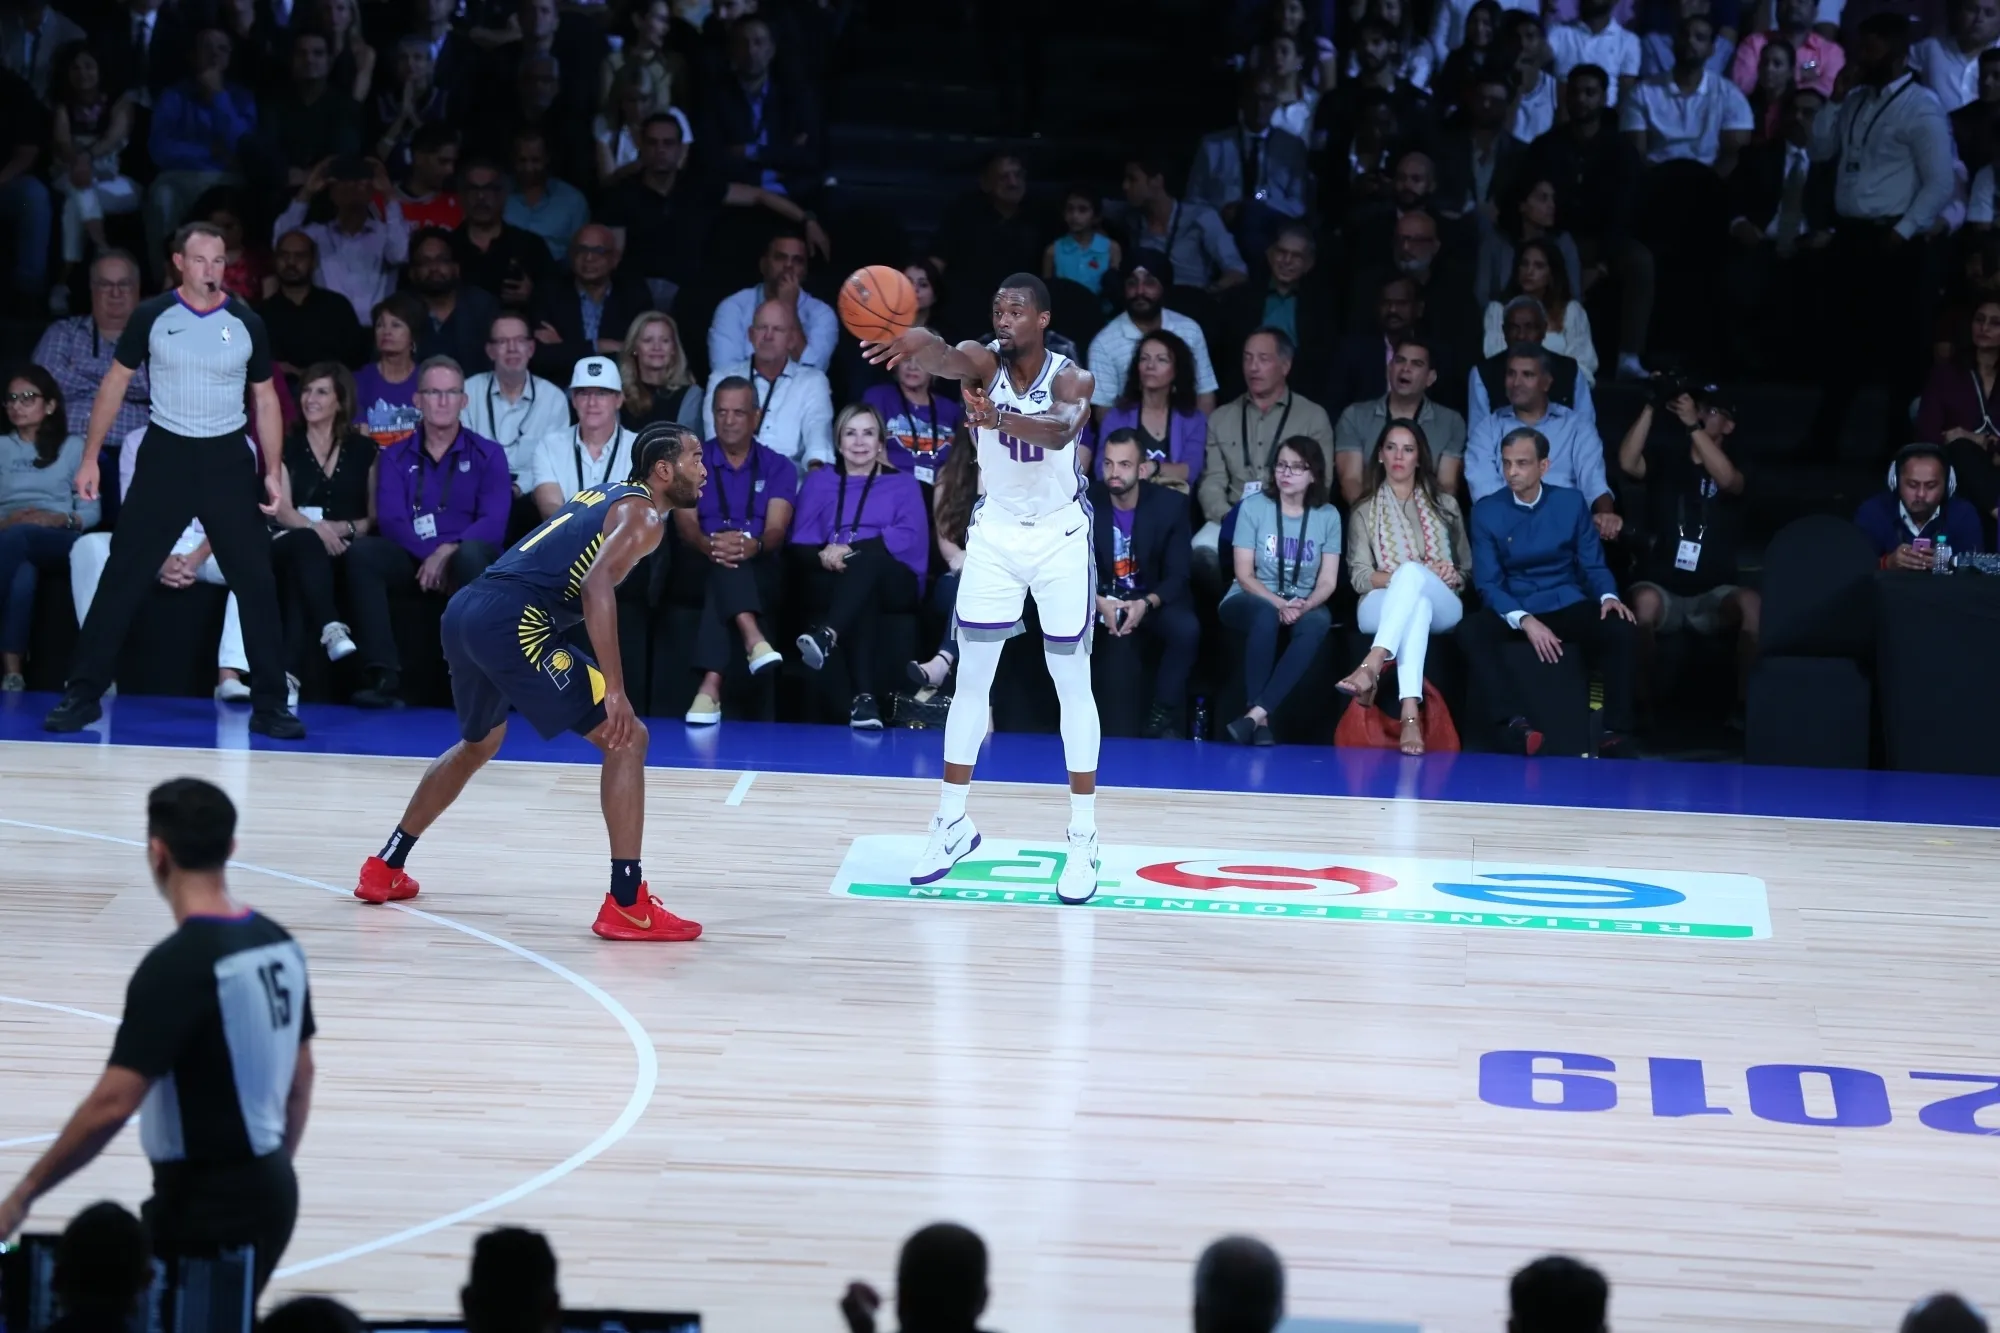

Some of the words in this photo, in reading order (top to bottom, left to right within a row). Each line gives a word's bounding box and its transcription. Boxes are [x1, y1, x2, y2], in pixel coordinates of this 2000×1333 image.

[519, 512, 574, 551] 1
[1361, 908, 1692, 934] RELIANCE
[257, 962, 291, 1031] 15
[1479, 1050, 2000, 1136] 2019
